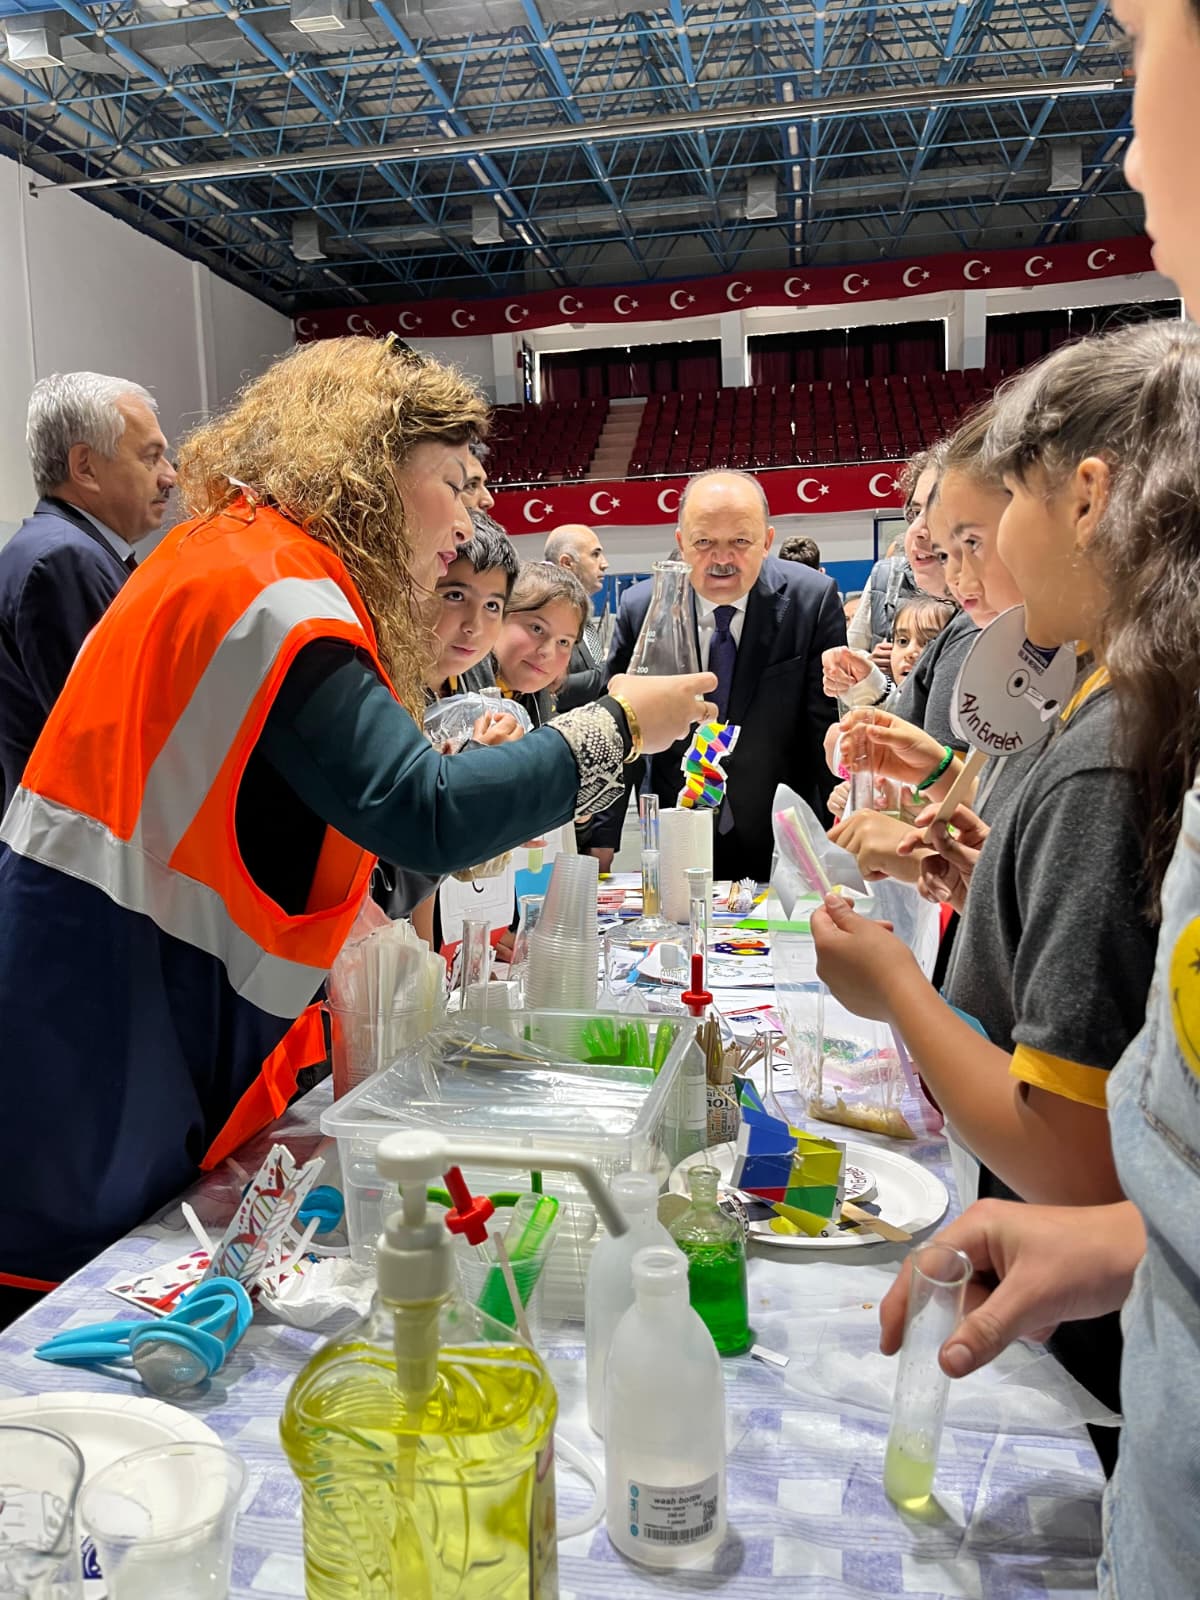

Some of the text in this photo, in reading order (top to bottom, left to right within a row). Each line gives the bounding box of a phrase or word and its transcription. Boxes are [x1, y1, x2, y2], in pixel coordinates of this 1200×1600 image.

[978, 722, 1023, 750] Evreleri
[820, 1230, 829, 1238] G
[678, 1494, 702, 1504] bottle
